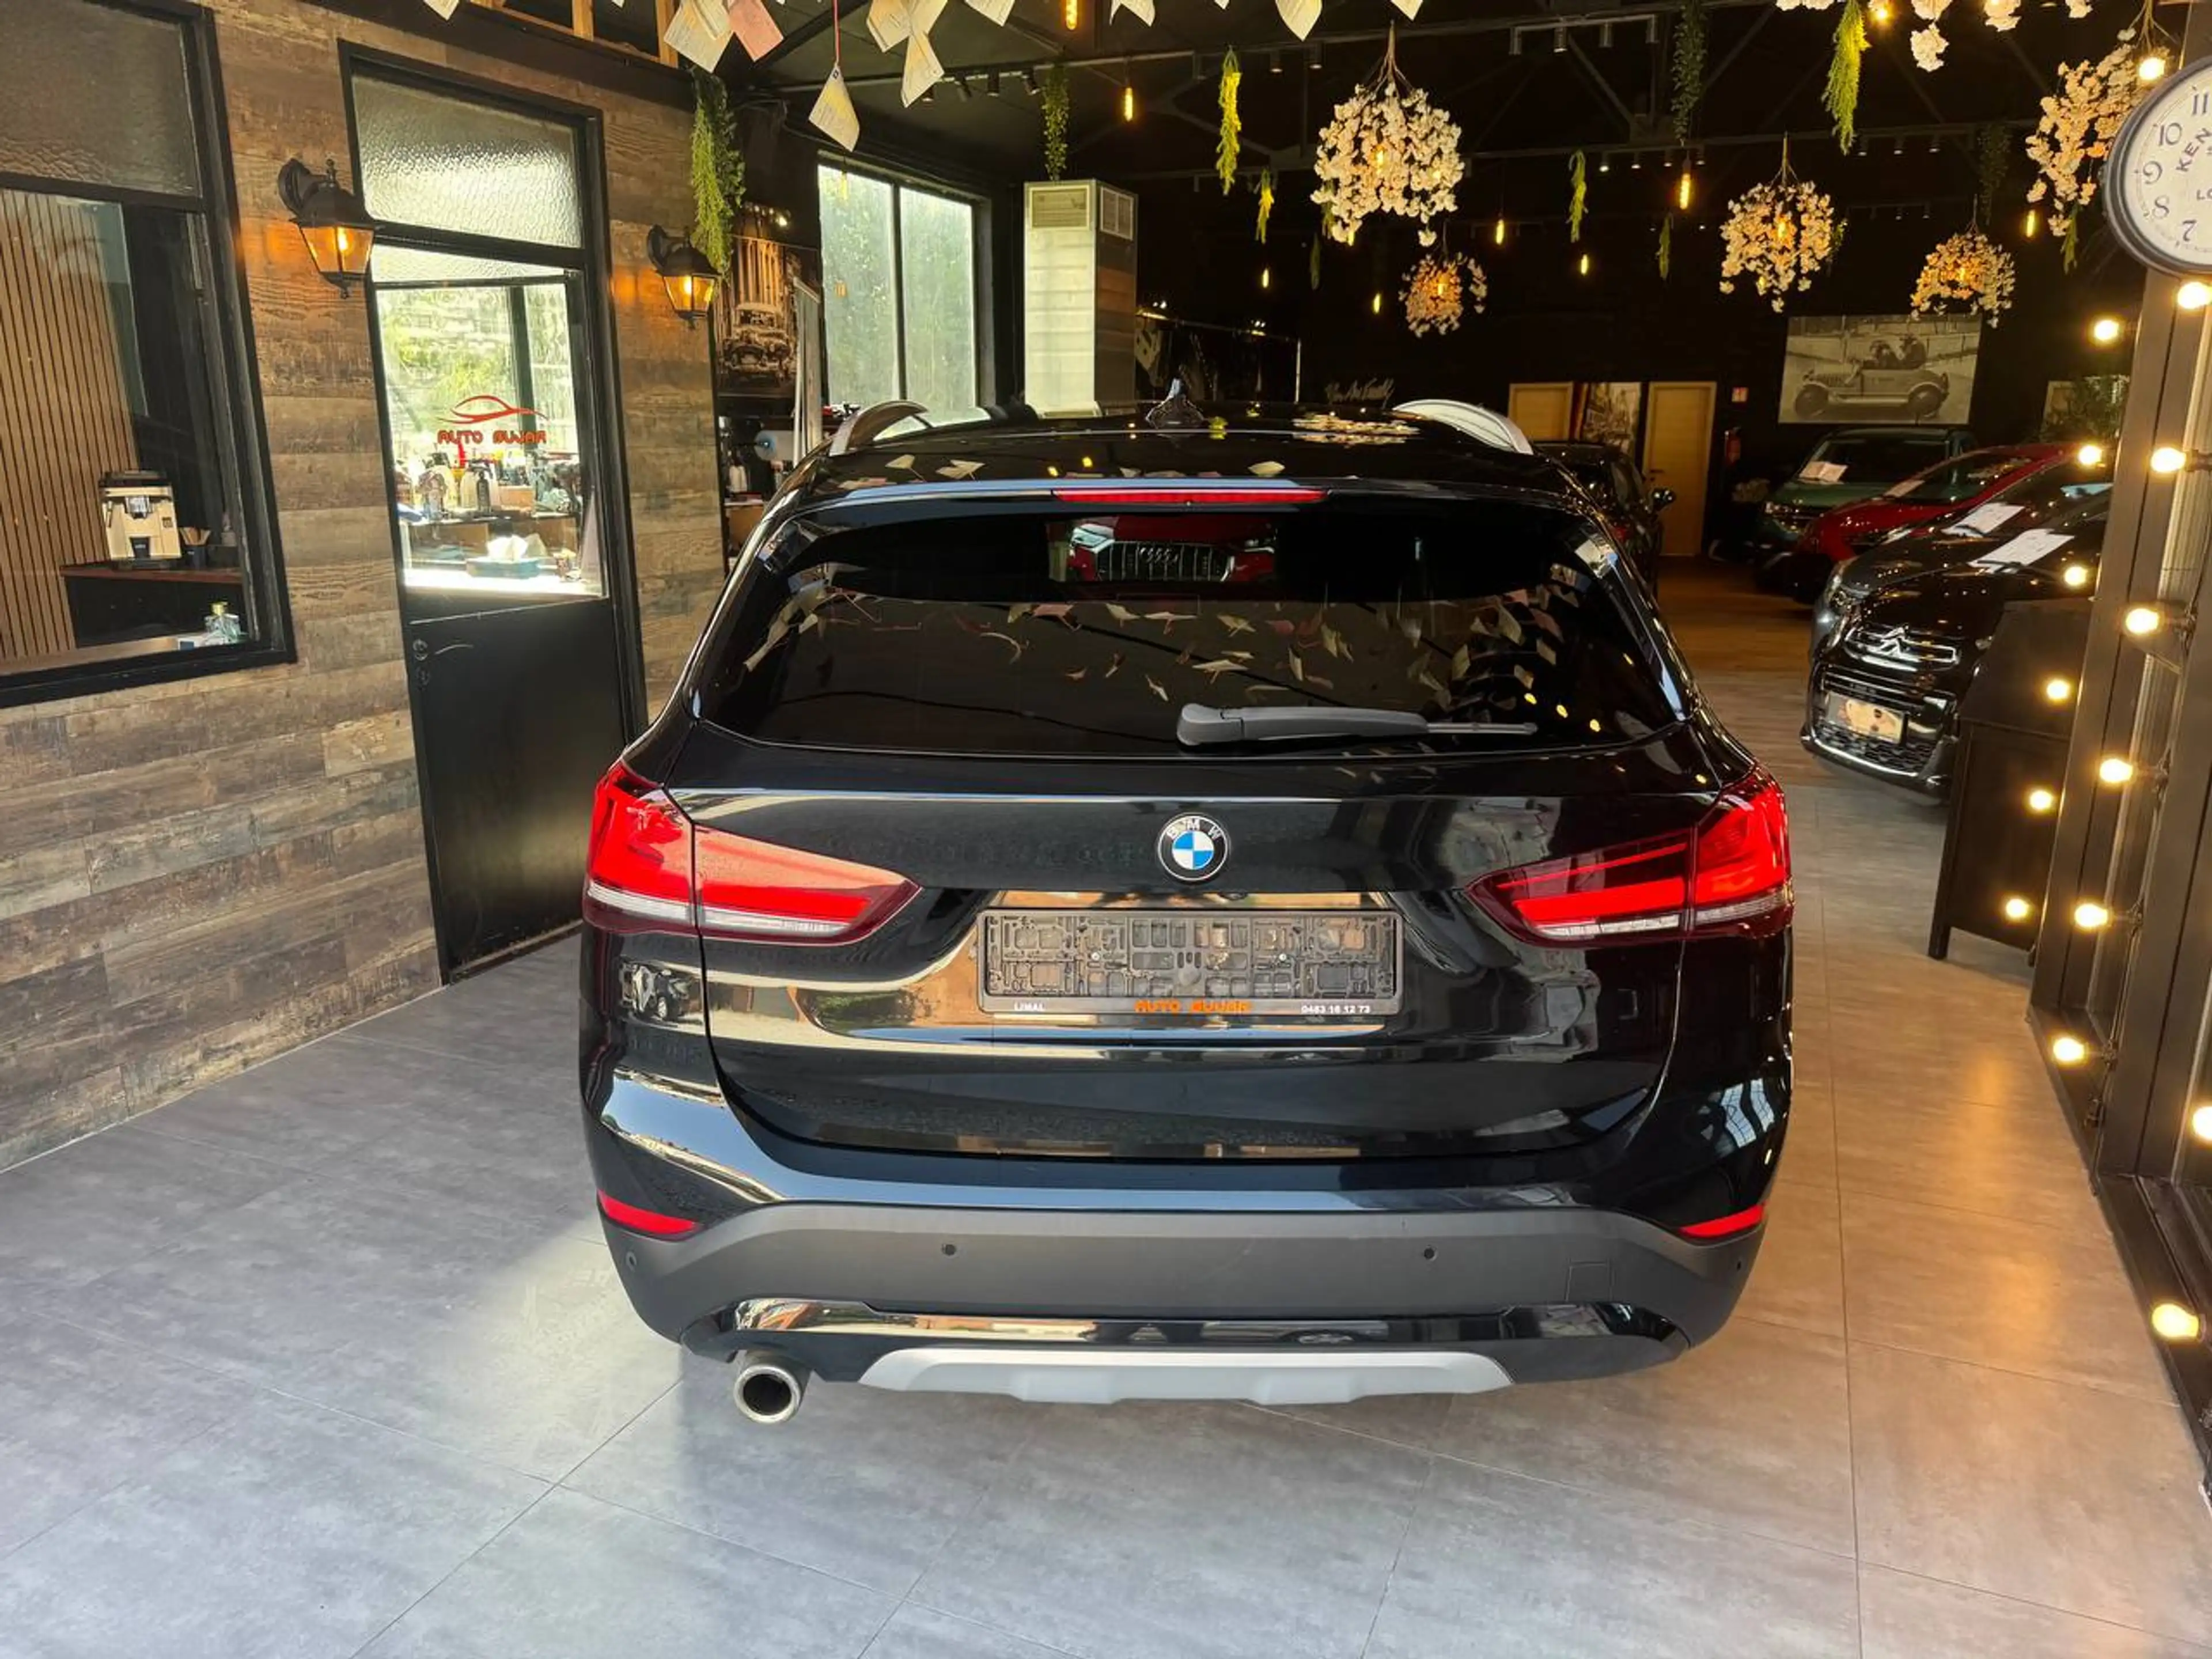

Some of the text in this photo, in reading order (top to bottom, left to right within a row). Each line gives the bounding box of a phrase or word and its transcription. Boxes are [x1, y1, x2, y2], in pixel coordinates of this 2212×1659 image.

[2192, 93, 2209, 115] 11
[2158, 122, 2183, 146] 10
[2142, 160, 2163, 185] 9
[2152, 194, 2171, 219] 8
[2182, 219, 2198, 242] 7
[437, 430, 484, 445] AUTO
[1165, 817, 1222, 840] BMW
[1134, 999, 1180, 1014] AUTO
